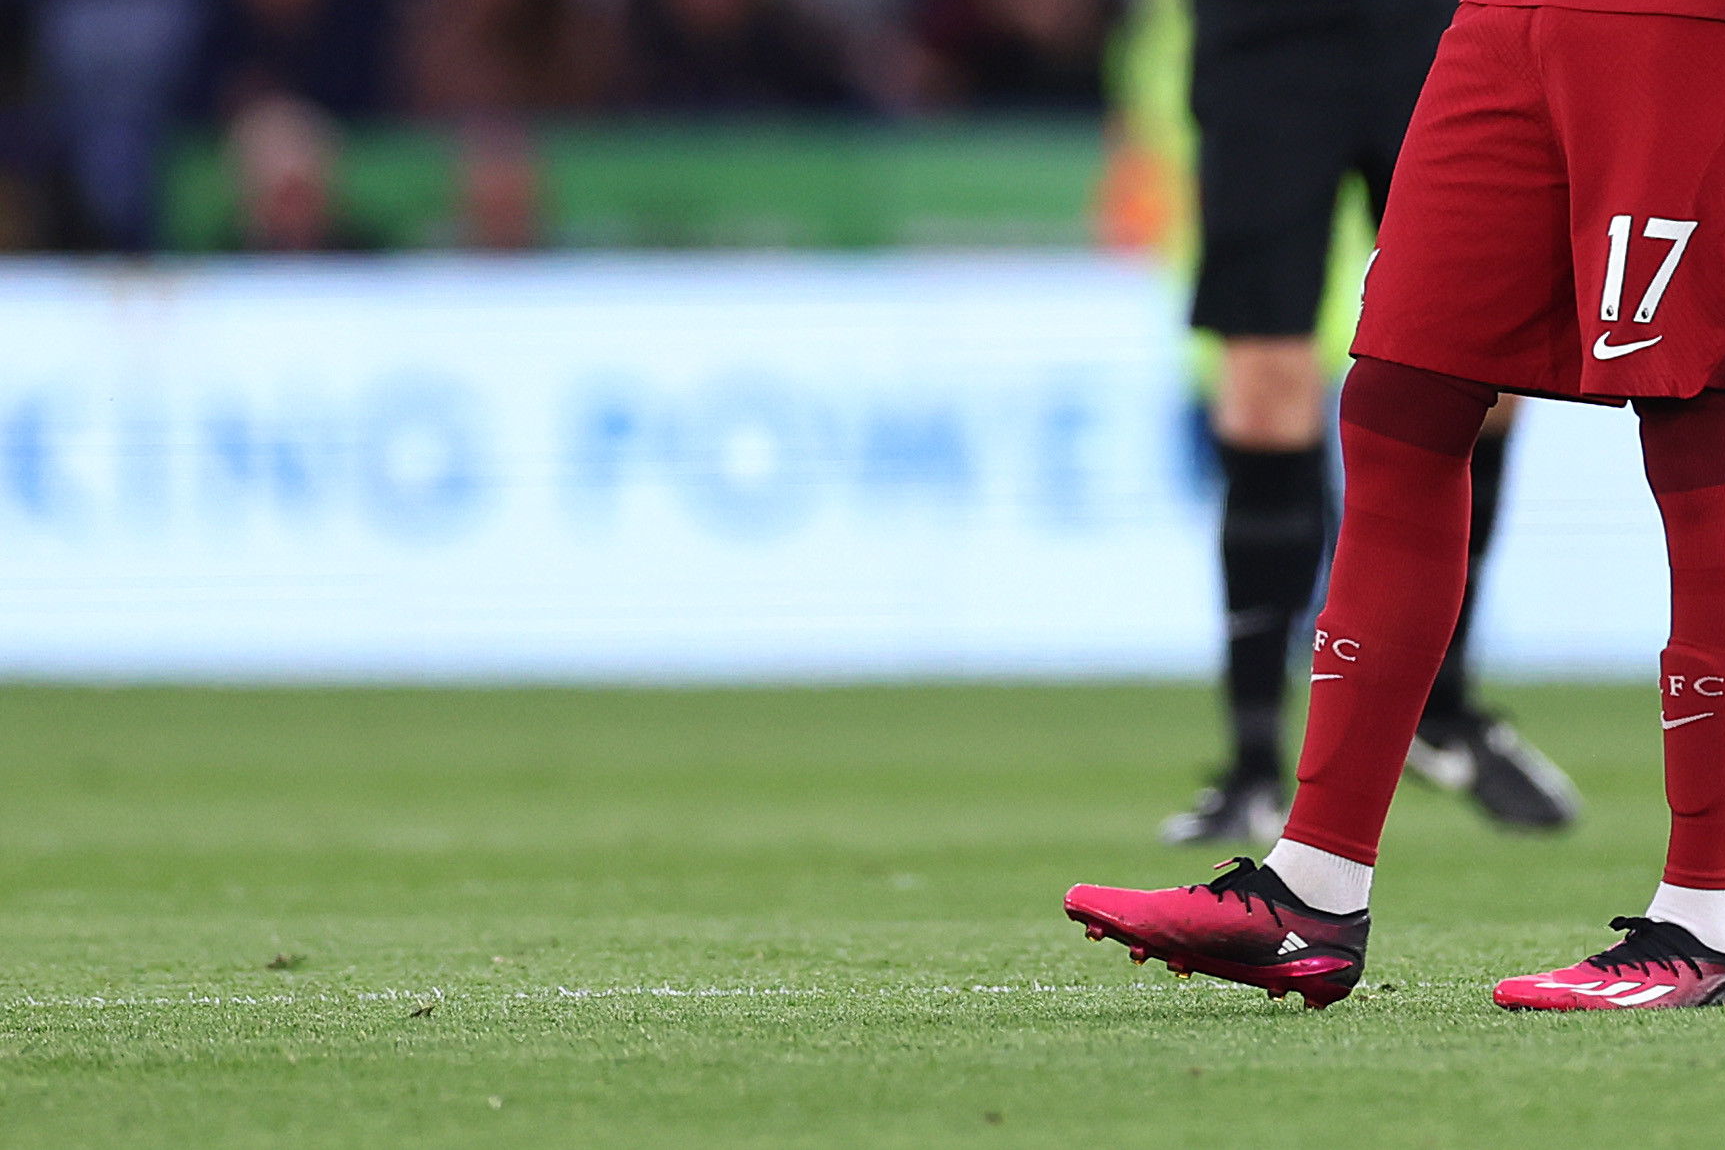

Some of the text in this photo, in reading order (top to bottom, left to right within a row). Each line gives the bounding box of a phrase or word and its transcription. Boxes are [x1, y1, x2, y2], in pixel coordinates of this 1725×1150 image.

[1600, 215, 1698, 323] 17
[1312, 629, 1360, 662] FC
[1658, 675, 1725, 697] FC
